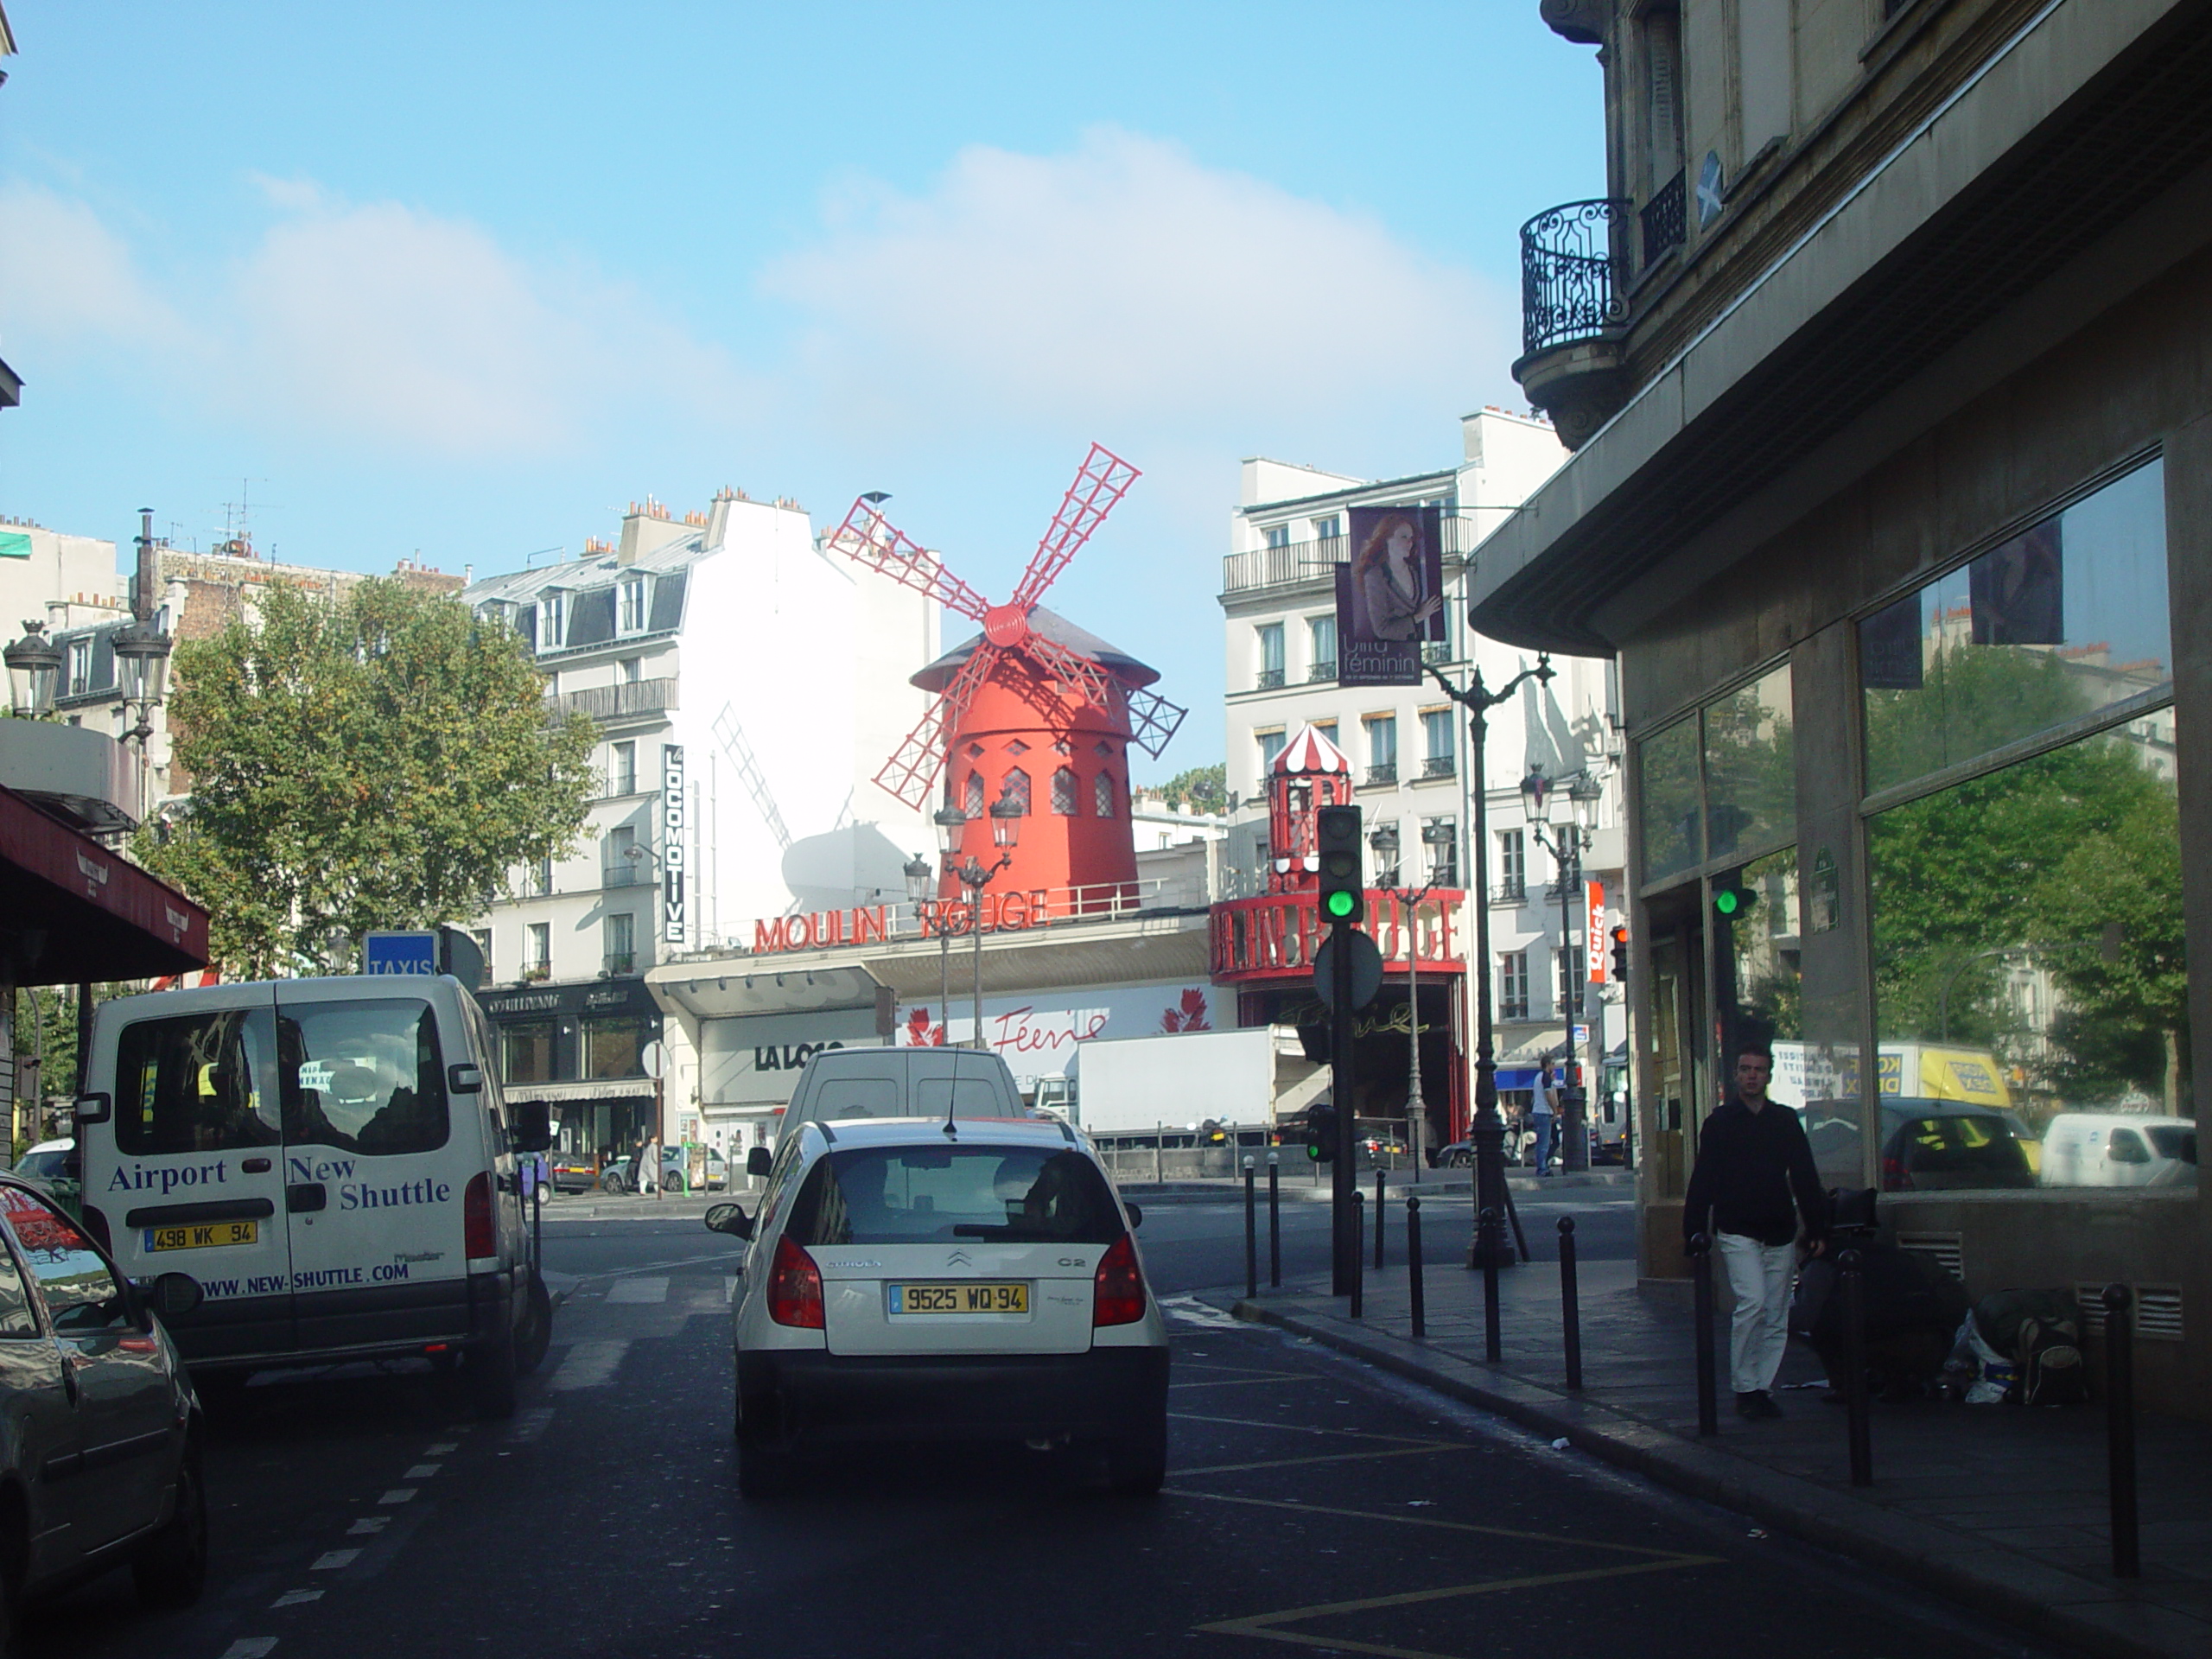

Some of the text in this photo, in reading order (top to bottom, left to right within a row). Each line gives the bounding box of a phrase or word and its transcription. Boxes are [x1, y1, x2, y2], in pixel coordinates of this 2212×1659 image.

[1344, 652, 1414, 673] féminin
[666, 751, 683, 941] LOCOMOTIVE
[755, 889, 1051, 954] MOULIN ROUGE
[1589, 904, 1605, 970] Quick
[370, 960, 431, 975] TAXIS
[993, 1005, 1107, 1055] Féerie
[754, 1046, 781, 1071] LA
[107, 1159, 227, 1195] Airport
[288, 1156, 356, 1184] New
[340, 1178, 450, 1211] Shuttle
[156, 1229, 187, 1249] 498
[194, 1226, 214, 1245] WK
[231, 1224, 251, 1243] 94
[1057, 1257, 1087, 1268] C2
[201, 1263, 410, 1297] WW.NEW-SHUTTLE.COM
[908, 1288, 957, 1310] 9525
[967, 1287, 992, 1310] WQ
[997, 1287, 1022, 1309] 94
